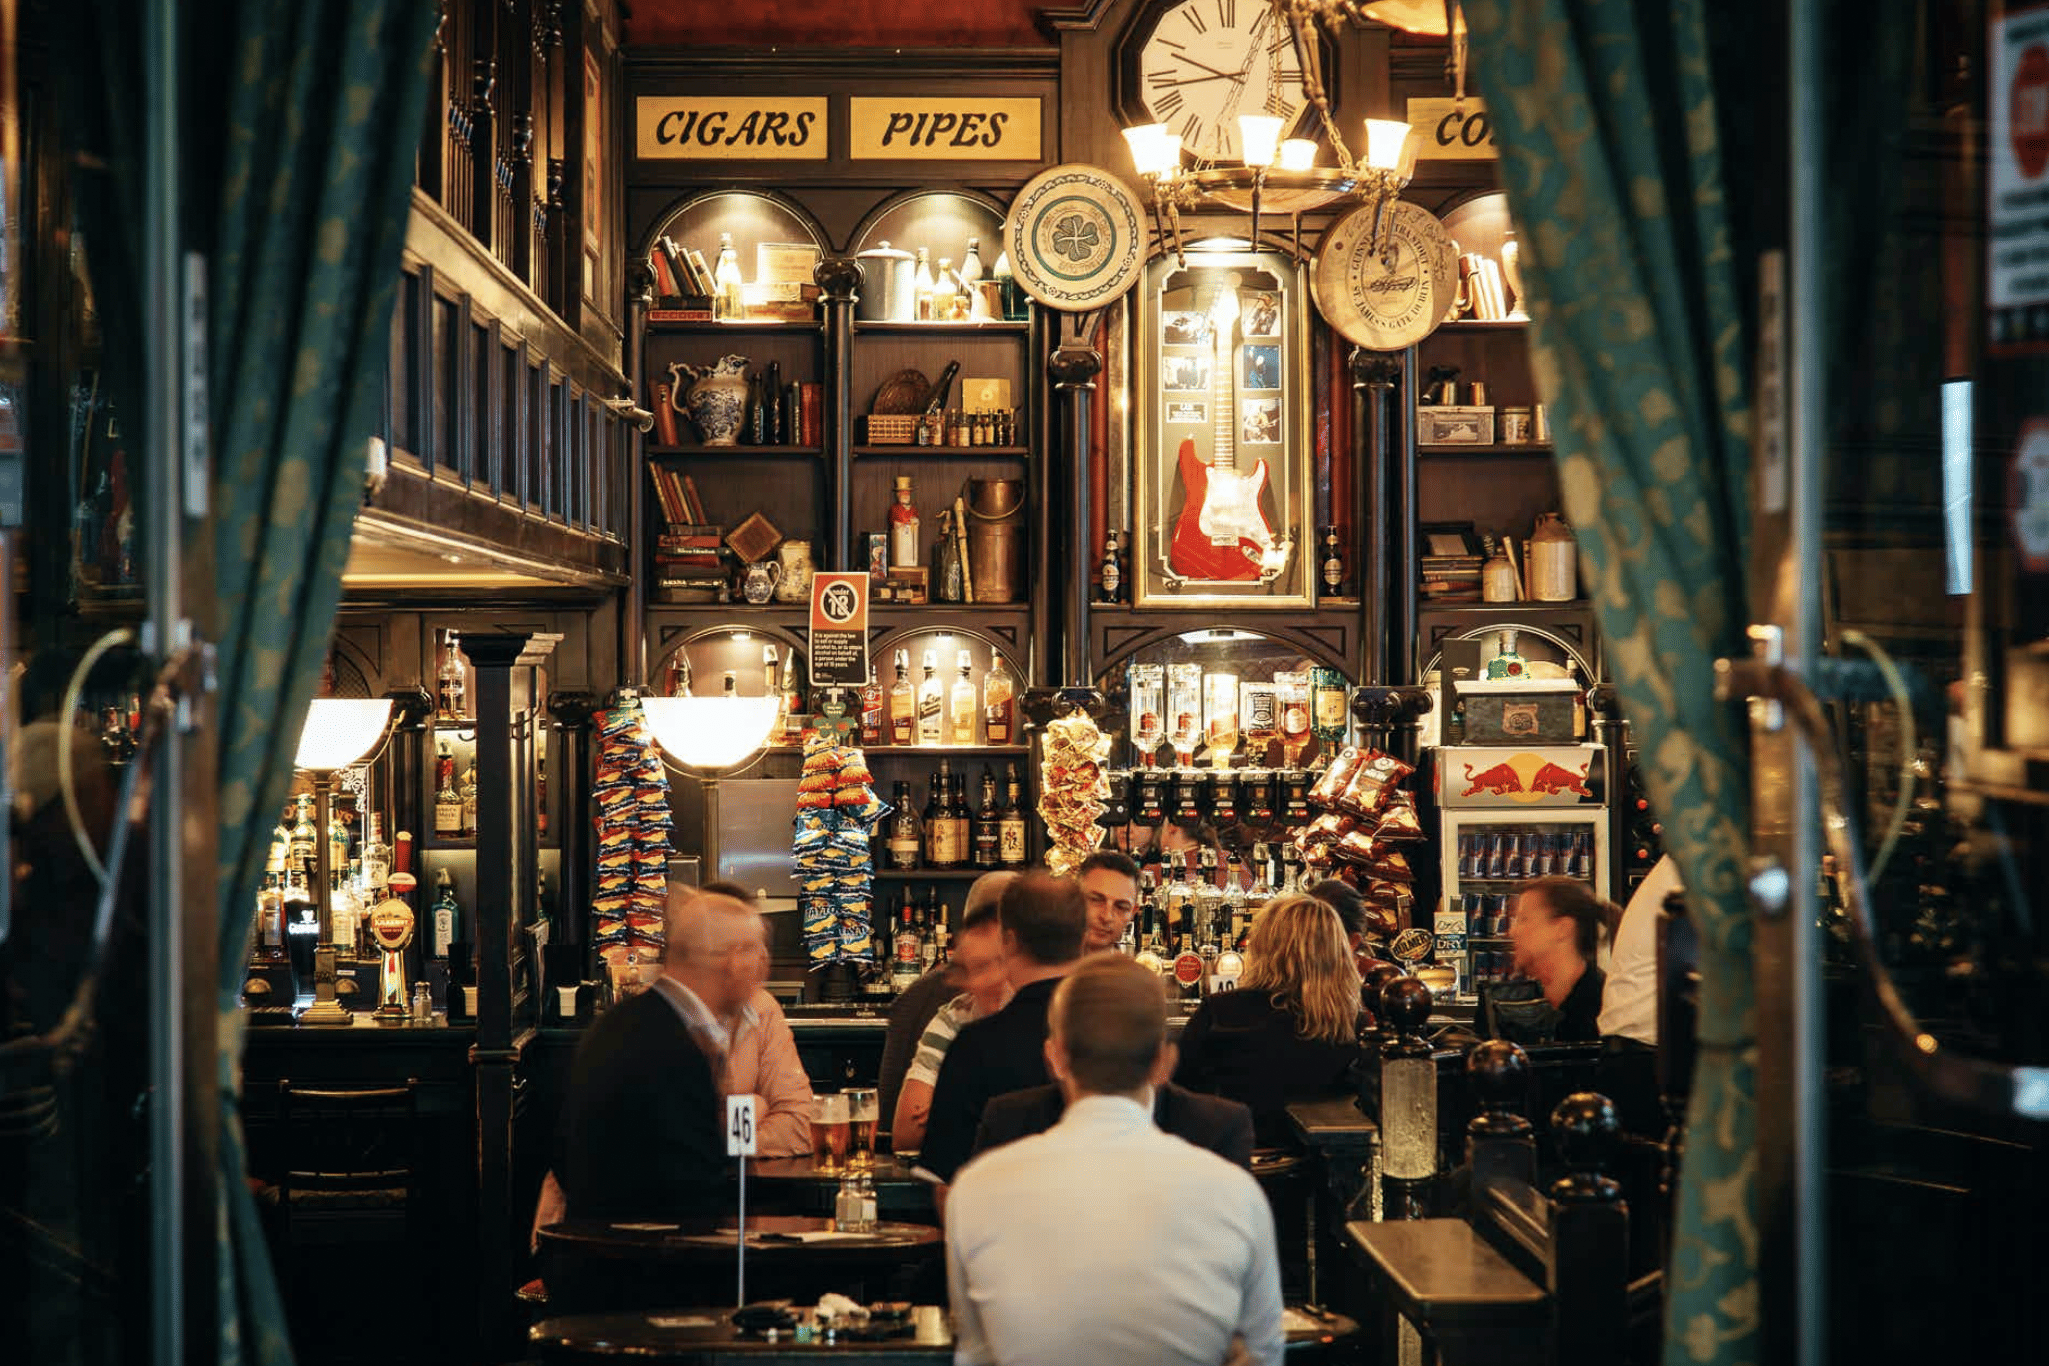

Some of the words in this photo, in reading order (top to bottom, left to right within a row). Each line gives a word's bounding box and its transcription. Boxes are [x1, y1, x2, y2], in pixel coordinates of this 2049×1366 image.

[656, 110, 815, 147] CIGARS
[881, 111, 1009, 148] PIPES
[1436, 112, 1495, 147] CO
[828, 595, 849, 616] 18
[1437, 939, 1462, 949] DRY
[732, 1105, 751, 1145] 46
